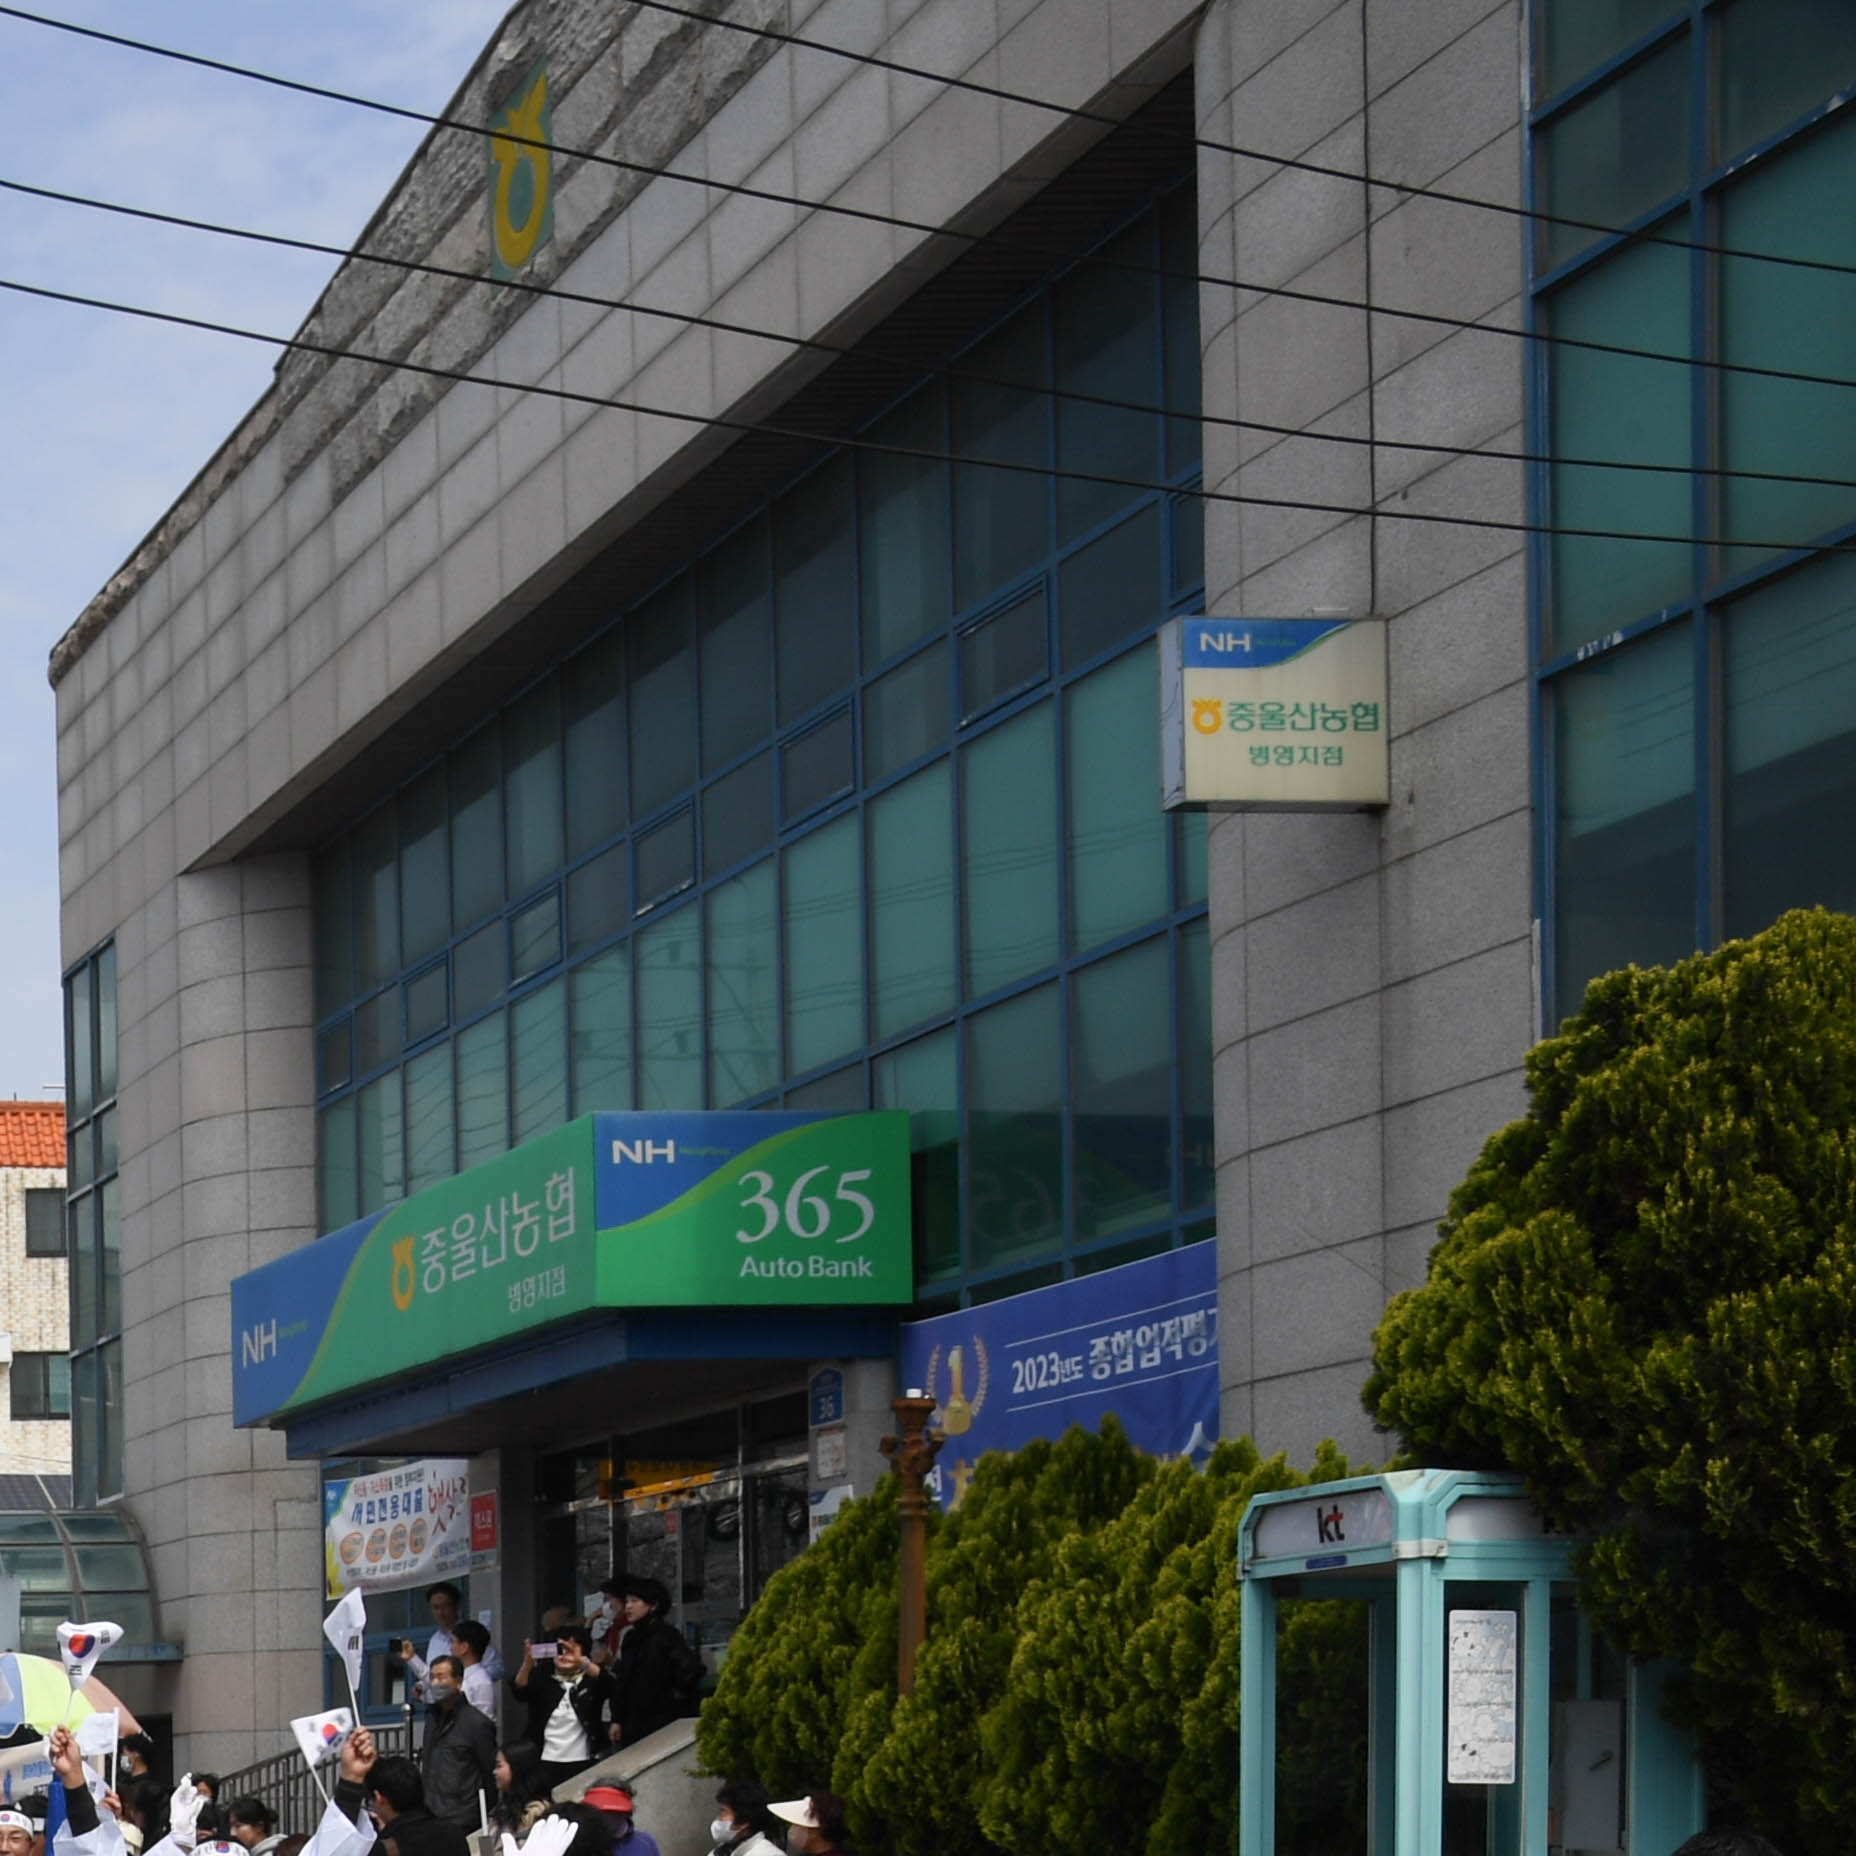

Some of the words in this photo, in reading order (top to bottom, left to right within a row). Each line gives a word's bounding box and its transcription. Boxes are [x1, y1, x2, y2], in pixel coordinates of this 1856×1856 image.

[1200, 632, 1251, 653] NH
[1227, 701, 1379, 732] 중울산농협
[1249, 745, 1344, 766] 병영지점
[611, 1139, 675, 1164] NH
[736, 1165, 875, 1244] 365
[421, 1166, 576, 1295] 중울산농협
[739, 1256, 803, 1278] Auto
[808, 1255, 874, 1278] Bank
[507, 1264, 567, 1313] 병영지점
[241, 1317, 277, 1369] NH
[1011, 1351, 1084, 1394] 2023년도
[1317, 1504, 1345, 1544] kt
